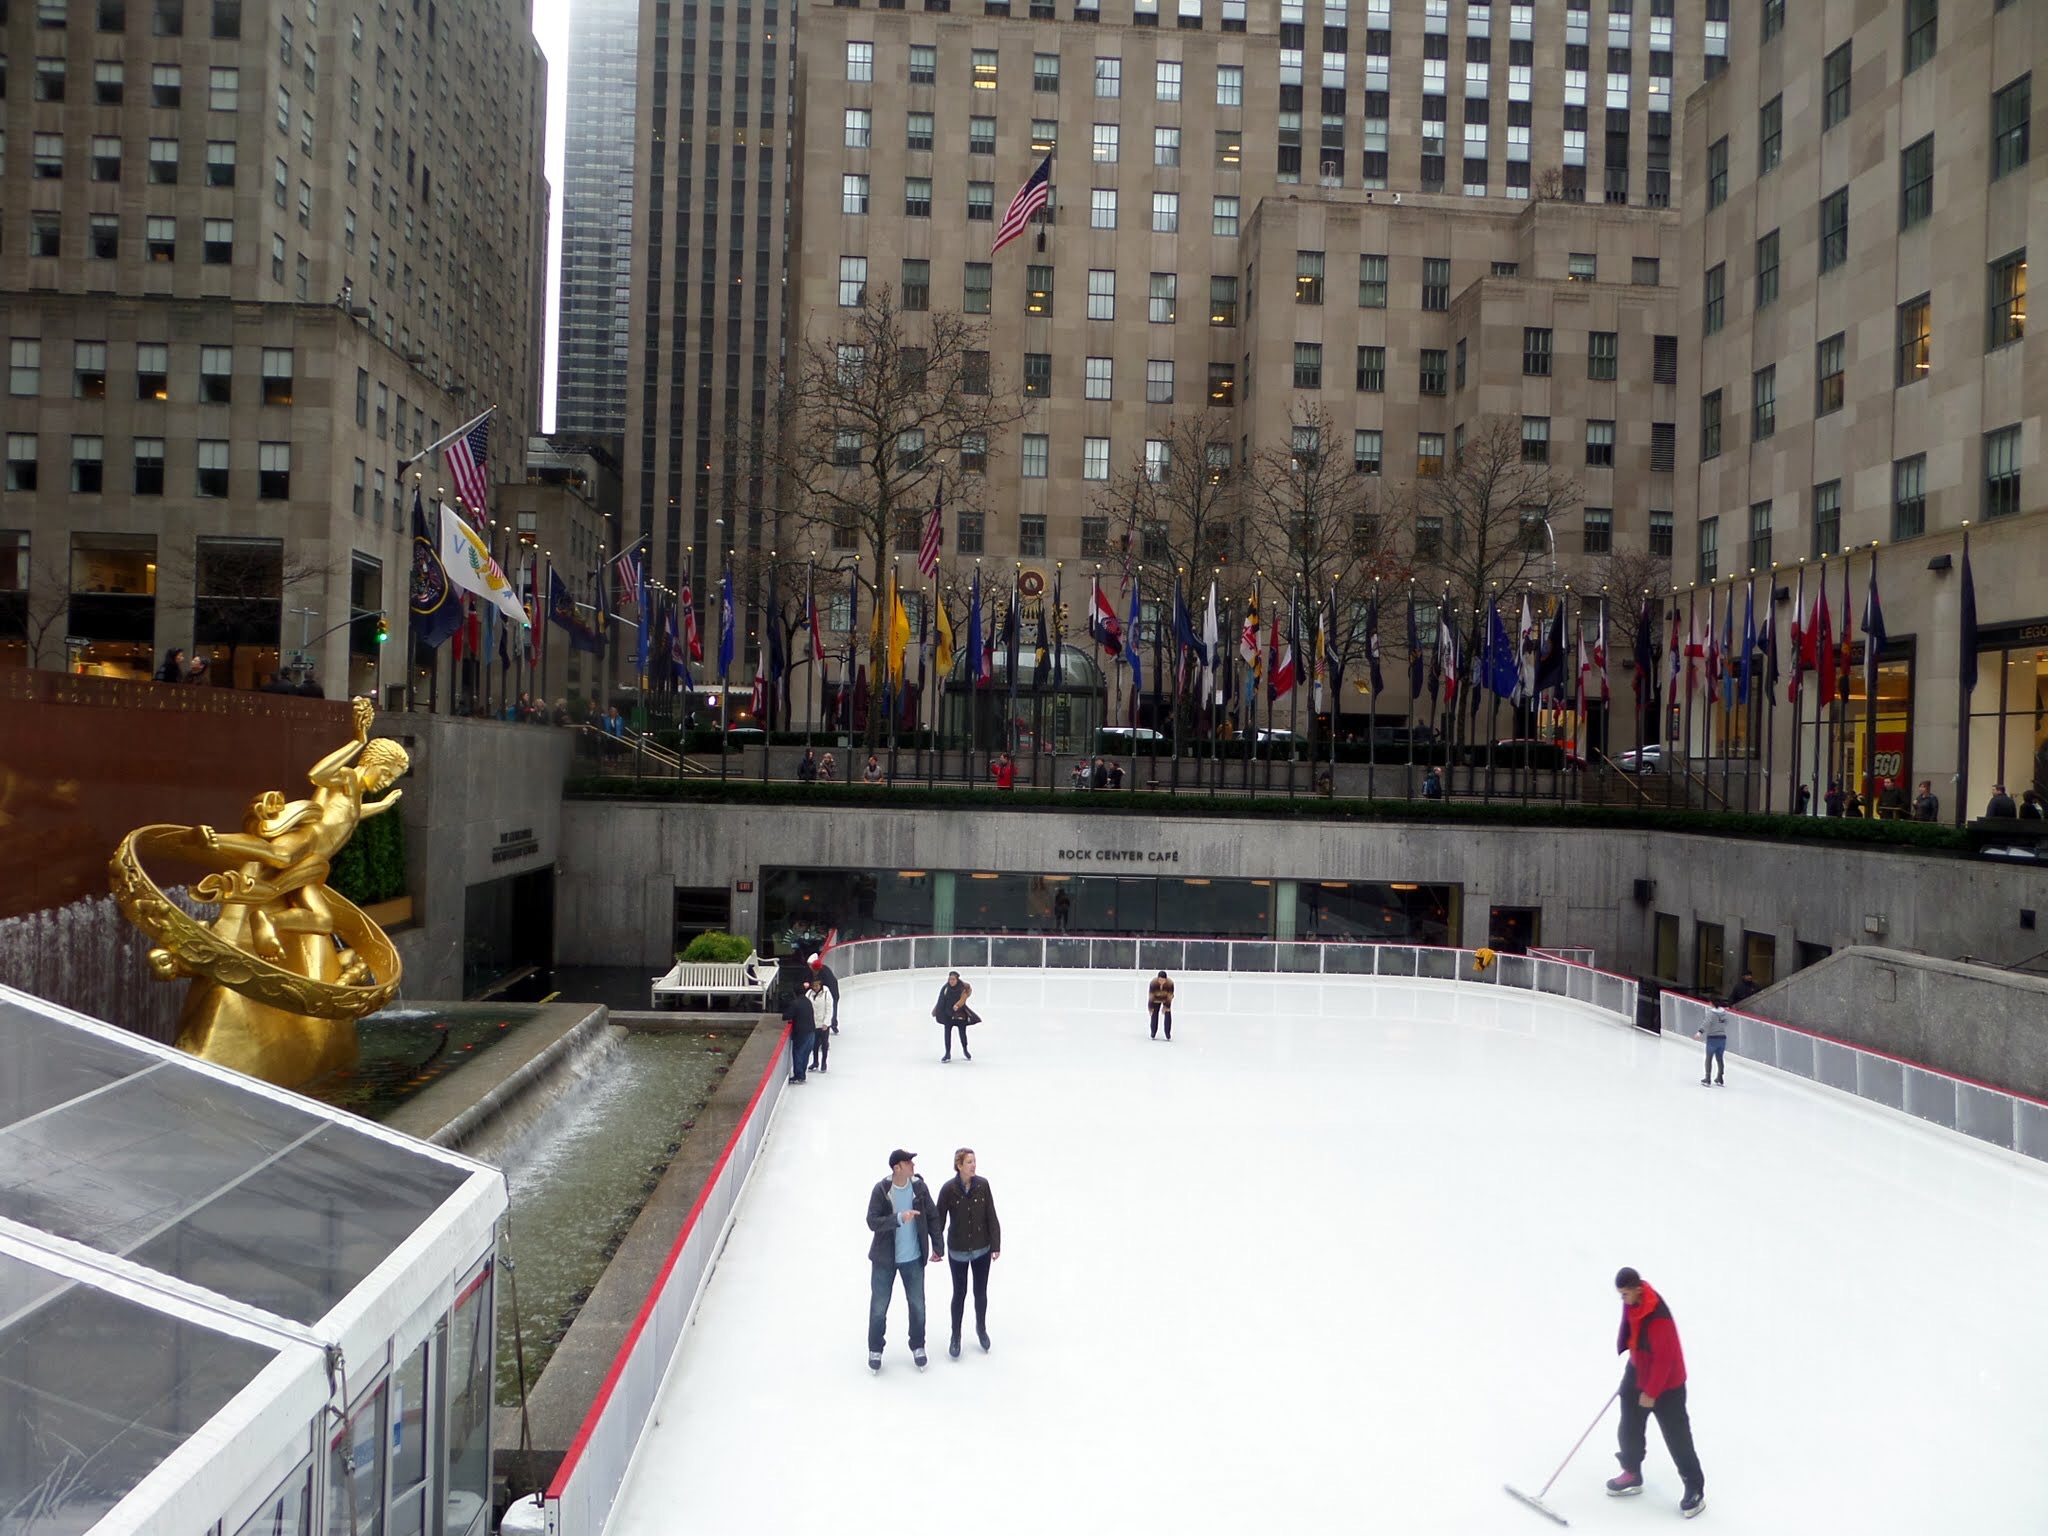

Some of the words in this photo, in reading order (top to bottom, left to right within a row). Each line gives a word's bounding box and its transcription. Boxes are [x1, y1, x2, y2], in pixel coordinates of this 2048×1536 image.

[2019, 624, 2048, 640] LEGO
[1874, 753, 1901, 776] EGO
[1058, 849, 1092, 860] ROCK
[1096, 850, 1143, 862] CENTER
[1148, 850, 1179, 862] CAFÉ
